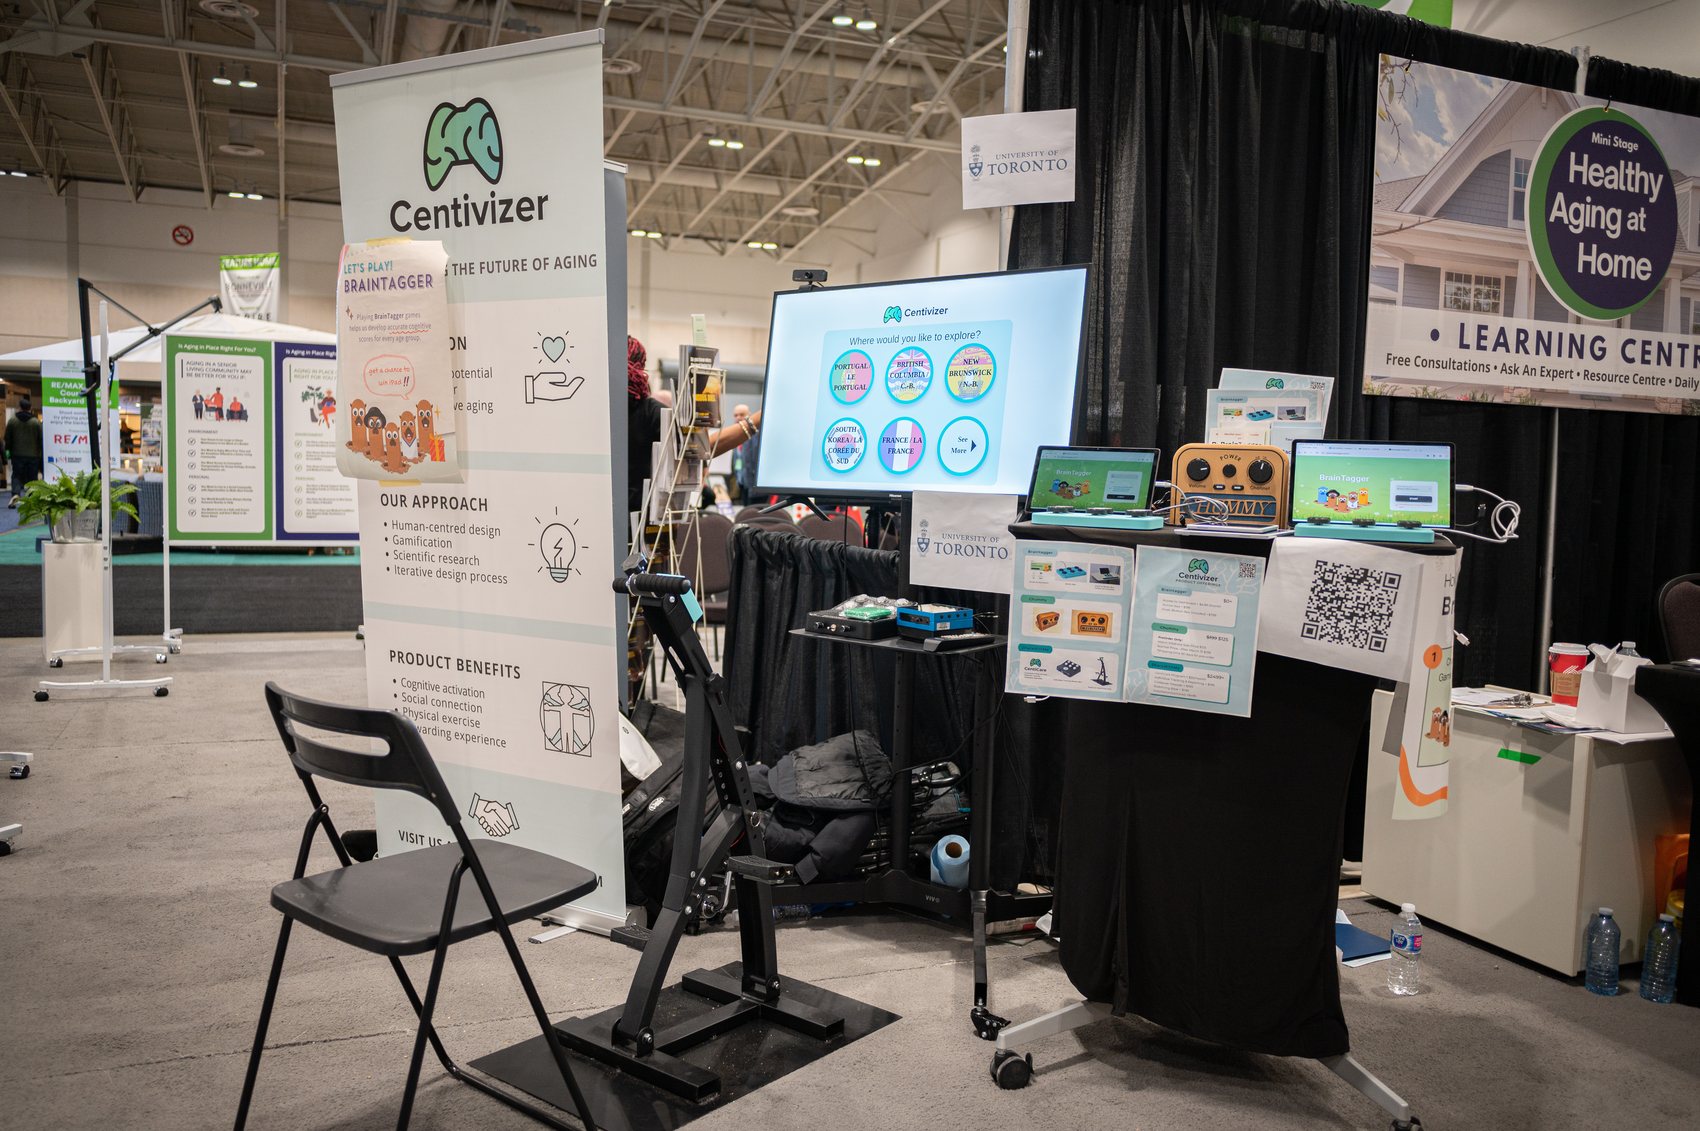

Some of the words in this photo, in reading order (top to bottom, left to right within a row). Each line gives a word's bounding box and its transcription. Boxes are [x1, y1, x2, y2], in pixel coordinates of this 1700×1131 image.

[1592, 132, 1611, 146] Mini
[1613, 135, 1638, 152] Stage
[995, 151, 1044, 160] UNIVERSITY
[988, 158, 1067, 176] TORONTO
[1569, 151, 1663, 202] Healthy
[390, 190, 548, 232] Centivizer
[1550, 192, 1622, 239] Aging
[1627, 208, 1646, 232] at
[344, 262, 364, 274] LET'S
[368, 260, 393, 272] PLAY!
[452, 262, 475, 276] THE
[480, 259, 528, 274] FUTURE
[533, 258, 550, 271] OF
[554, 254, 597, 269] AGING
[1578, 242, 1652, 281] Home
[344, 274, 433, 293] BRAINTAGGER
[904, 306, 948, 317] Centivizer
[849, 337, 874, 346] Where
[877, 335, 899, 344] would
[901, 335, 916, 344] you
[918, 333, 932, 342] like
[935, 334, 942, 342] to
[944, 330, 981, 343] explore?
[1459, 323, 1606, 361] LEARNING
[184, 344, 198, 352] Aging
[369, 368, 378, 376] get
[1386, 353, 1410, 366] Free
[1414, 356, 1490, 373] Consultations
[1500, 363, 1519, 376] Ask
[1523, 364, 1536, 376] An
[1540, 366, 1574, 380] Expert
[1584, 370, 1630, 384] Resource
[1633, 374, 1666, 386] Centre
[1675, 377, 1699, 391] Daily
[50, 397, 84, 405] Backyard
[466, 401, 494, 414] aging
[1319, 474, 1370, 483] BrainTagger
[380, 494, 407, 508] OUR
[412, 495, 488, 512] APPROACH
[392, 520, 466, 534] Human-centred
[469, 522, 501, 539] design
[942, 533, 987, 542] UNIVERSITY
[393, 535, 453, 549] Gamification
[934, 542, 1008, 559] TORONTO
[393, 550, 435, 564] Scientific
[439, 553, 480, 566] research
[394, 565, 433, 578] Iterative
[436, 566, 467, 583] design
[470, 573, 508, 585] process
[1179, 572, 1218, 582] Centivizer
[389, 650, 451, 670] PRODUCT
[456, 658, 521, 679] BENEFITS
[1432, 652, 1436, 662] 1
[401, 677, 440, 693] Cognitive
[442, 685, 485, 699] activation
[402, 692, 427, 705] Social
[431, 697, 483, 714] connection
[402, 706, 439, 722] Physical
[442, 714, 481, 729] exercise
[417, 726, 452, 741] warding
[454, 732, 507, 748] experience
[398, 829, 424, 845] VISIT
[429, 836, 442, 847] US
